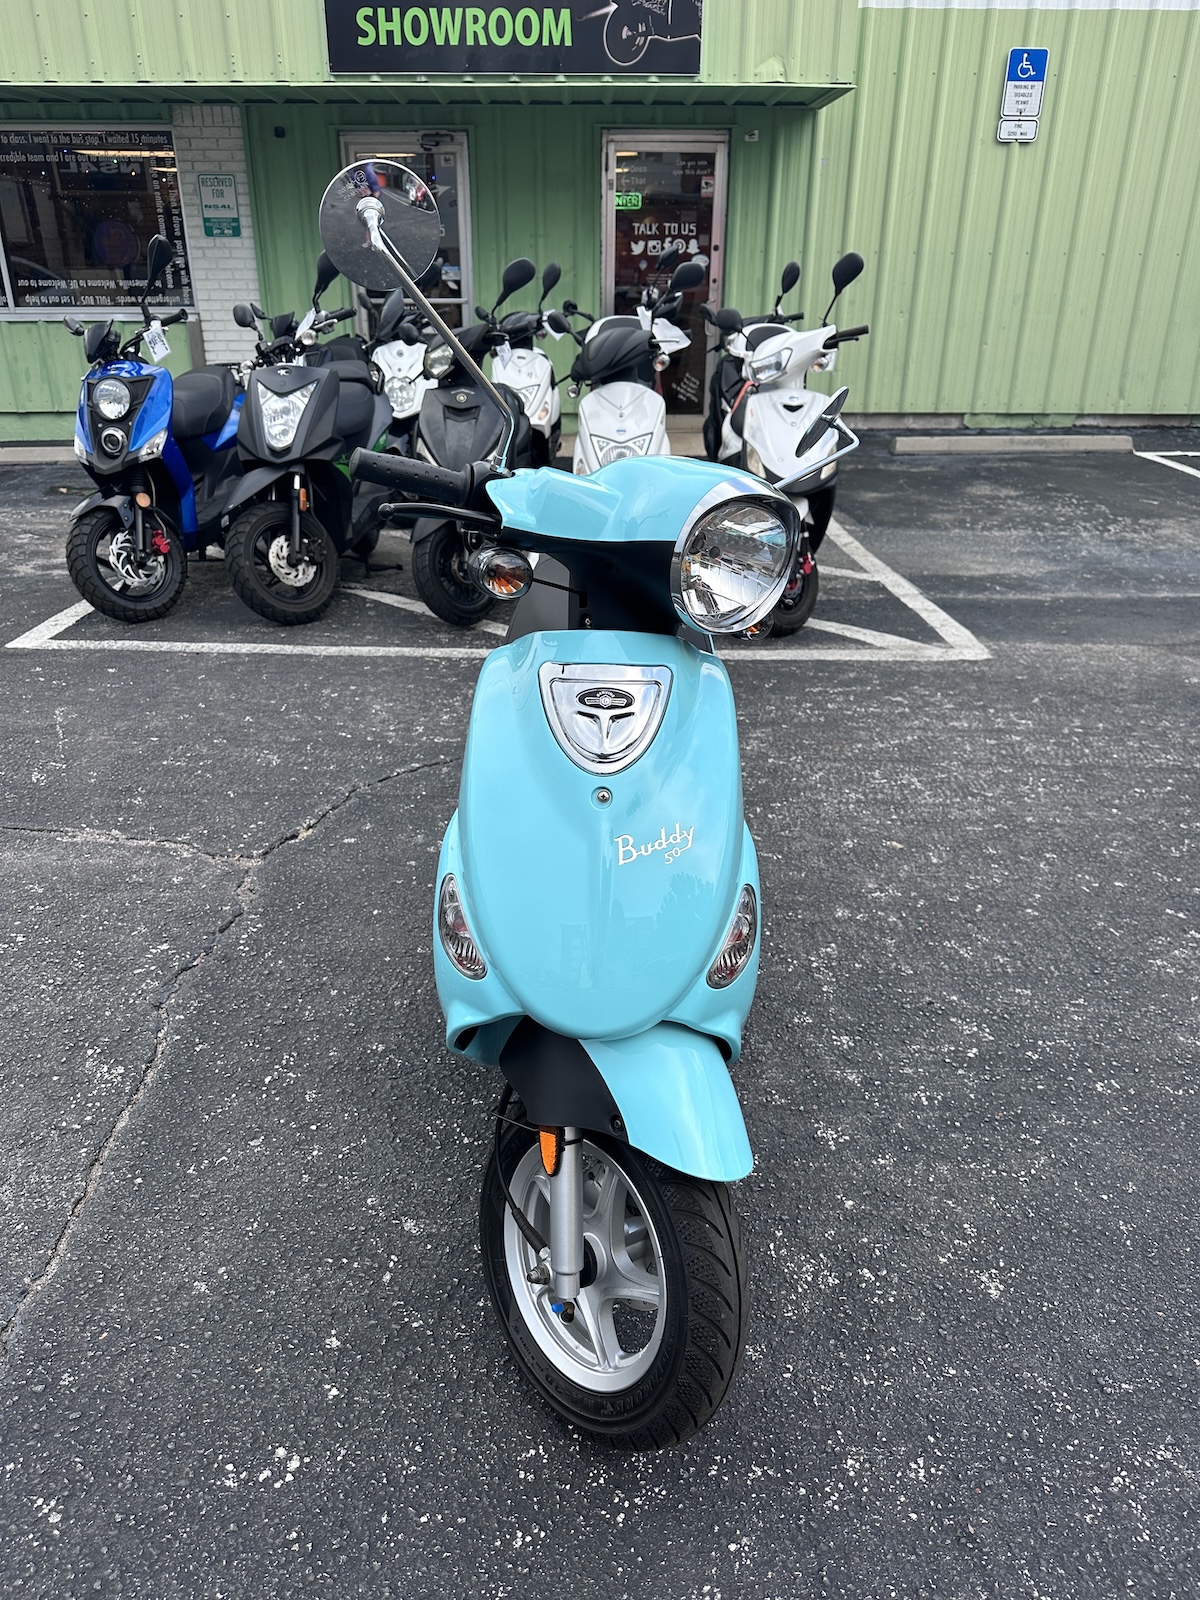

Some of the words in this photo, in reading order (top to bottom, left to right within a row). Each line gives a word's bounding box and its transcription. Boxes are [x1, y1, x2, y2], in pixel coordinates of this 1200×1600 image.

[355, 6, 573, 47] SHOWROOM
[1, 134, 8, 144] to
[8, 133, 27, 144] class.
[33, 134, 50, 144] went
[51, 134, 58, 144] to
[58, 133, 70, 144] the
[71, 133, 84, 144] bus
[85, 134, 102, 145] stop.
[107, 133, 129, 144] waited
[131, 133, 140, 144] 15
[140, 134, 168, 145] minutes
[27, 152, 45, 162] team
[46, 151, 59, 162] and
[64, 153, 77, 162] are
[77, 152, 89, 162] out
[90, 152, 97, 162] to
[153, 179, 160, 190] an
[167, 172, 176, 188] bus.
[200, 177, 233, 188] RESERVED
[630, 176, 647, 185] That
[169, 189, 178, 207] Then
[211, 188, 225, 199] FOR
[154, 191, 163, 213] entire
[172, 216, 182, 237] drove
[632, 222, 660, 236] TALK
[663, 222, 679, 236] TO
[680, 222, 697, 236] US
[174, 239, 185, 256] past
[180, 270, 189, 285] with
[29, 280, 37, 288] to
[38, 279, 67, 289] Welcome
[79, 280, 87, 288] to
[88, 279, 117, 289] Welcome
[24, 294, 38, 306] help
[40, 296, 48, 304] to
[49, 296, 60, 305] out
[60, 295, 71, 305] set
[115, 296, 137, 305] words:
[182, 286, 191, 305] those
[613, 821, 695, 866] Buddy
